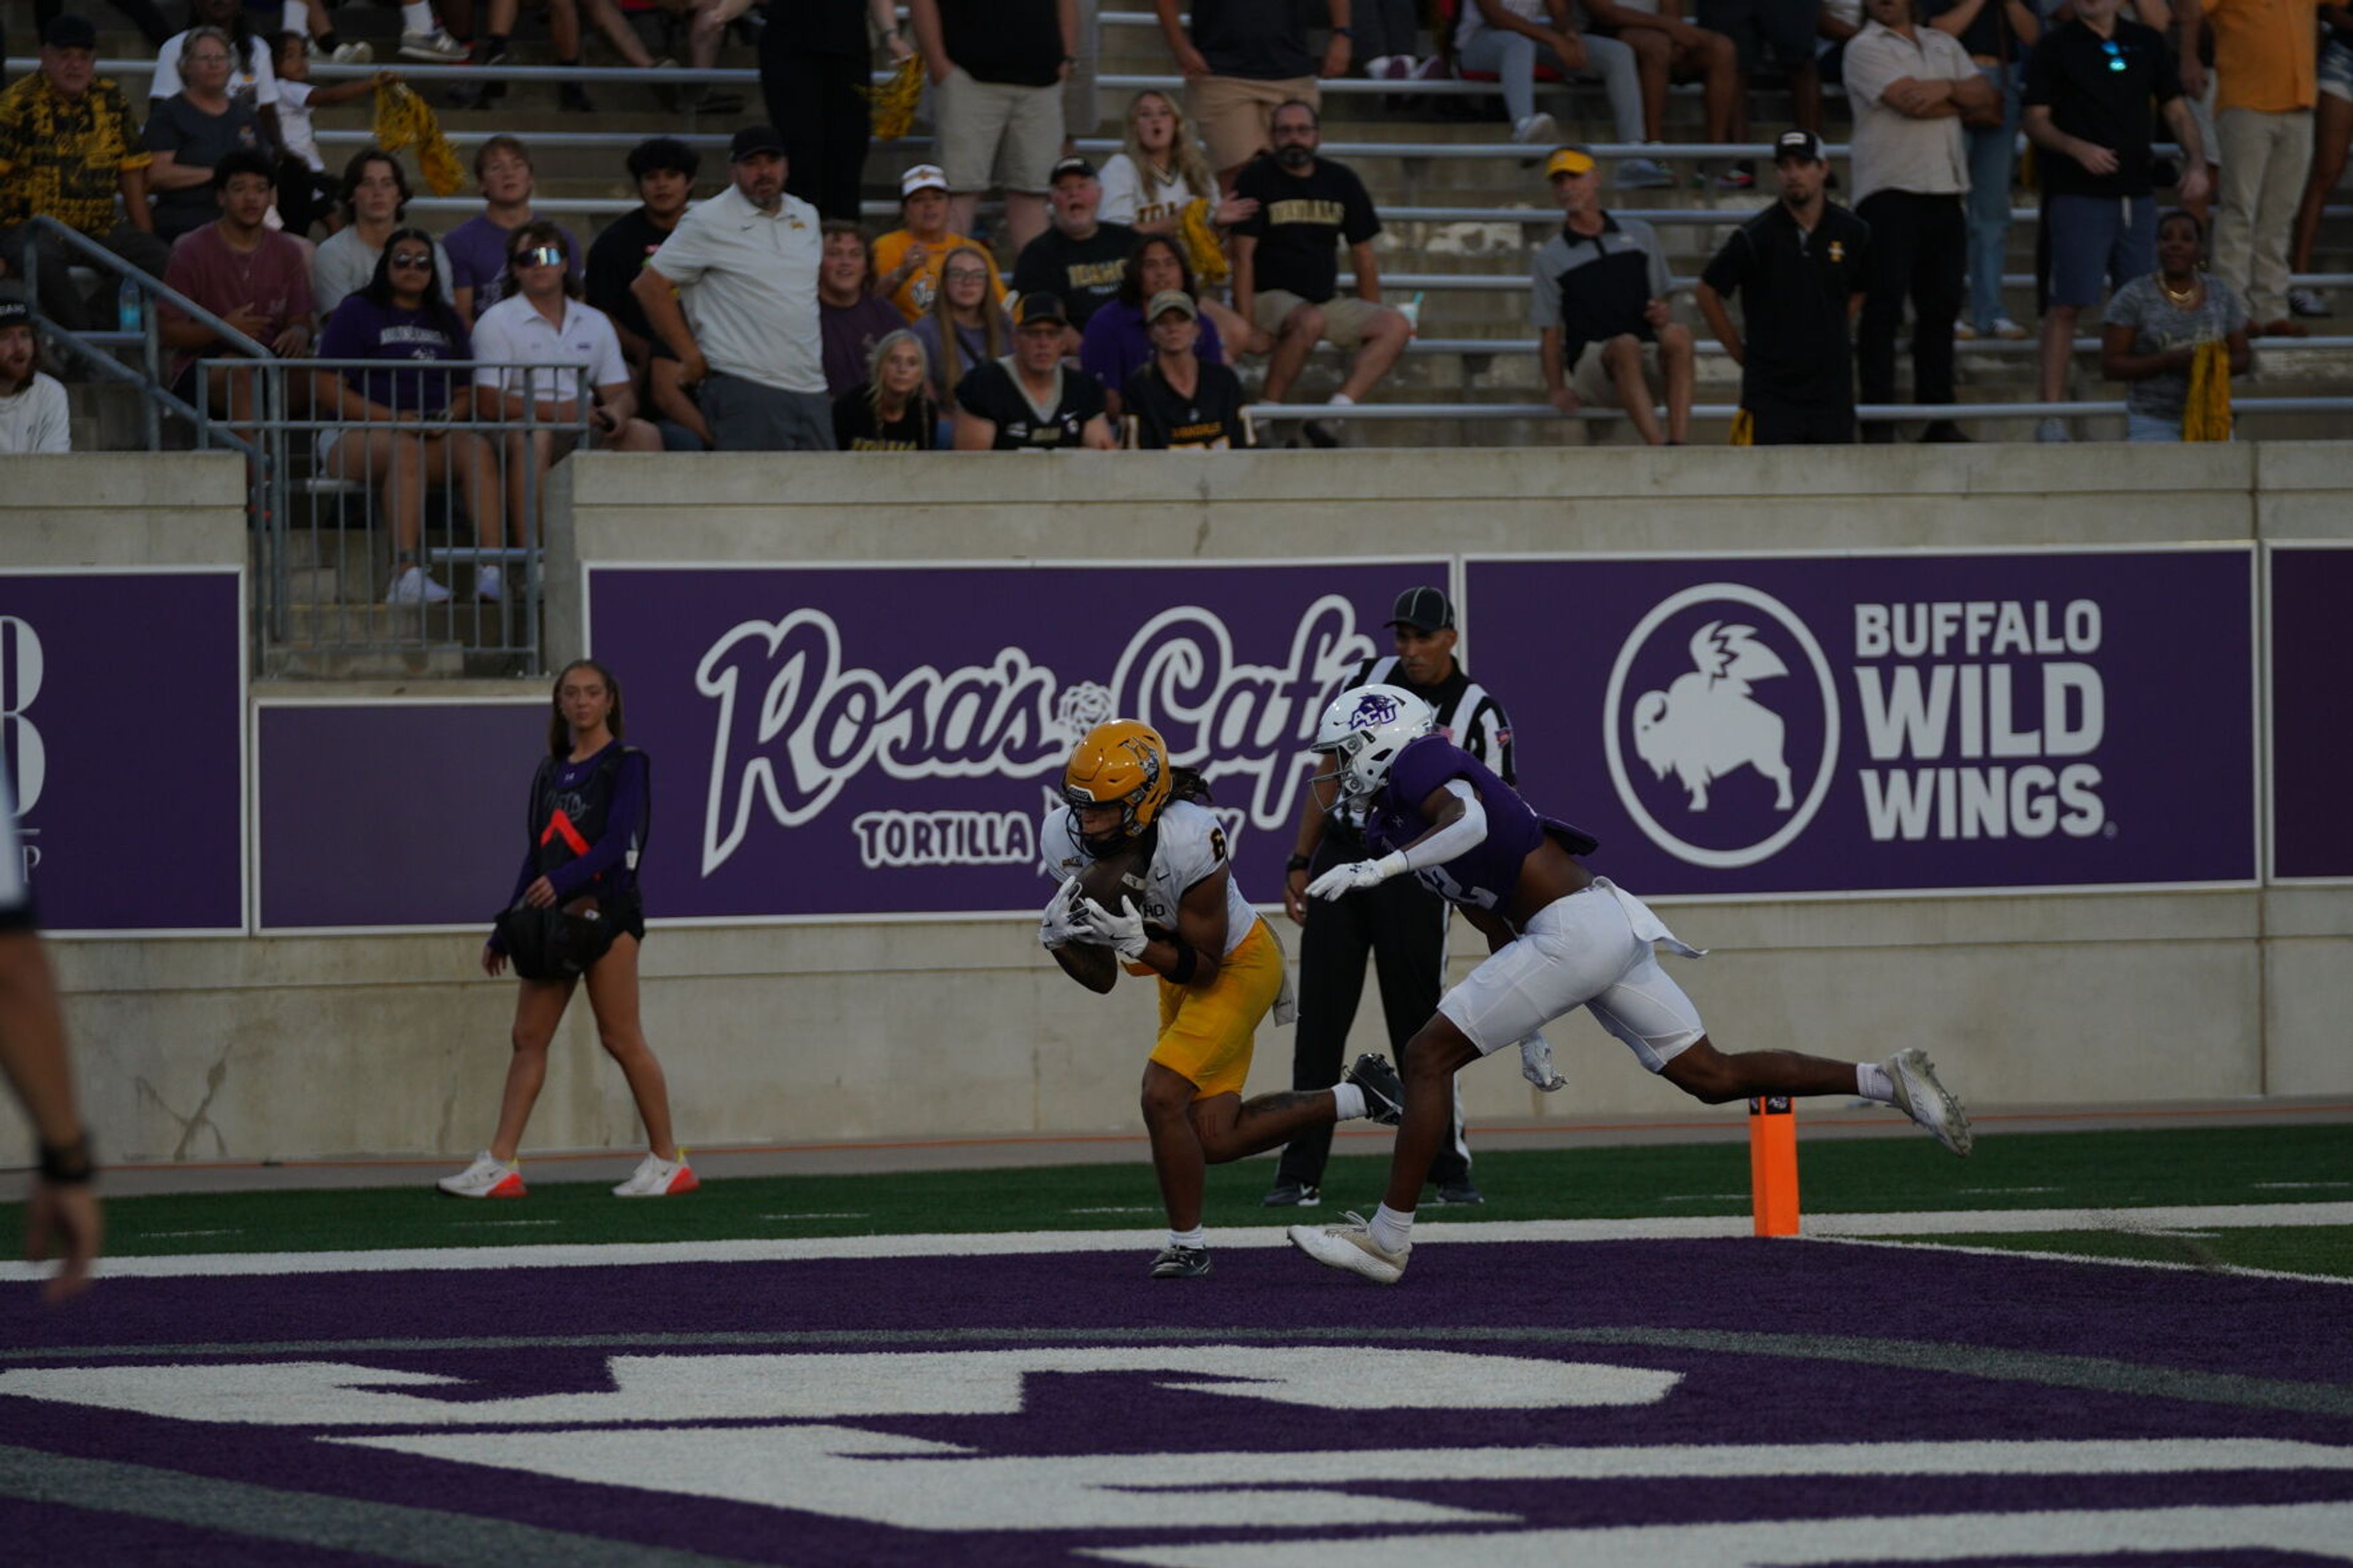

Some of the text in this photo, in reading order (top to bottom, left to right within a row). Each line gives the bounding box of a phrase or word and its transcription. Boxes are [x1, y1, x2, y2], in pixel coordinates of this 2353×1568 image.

[1854, 598, 2103, 658] BUFFALO
[694, 607, 1070, 878] Rosa's
[1349, 703, 1396, 730] ACU
[1854, 661, 2105, 761] WILD
[1859, 762, 2106, 841] WINGS
[852, 809, 1035, 869] TORTILLA
